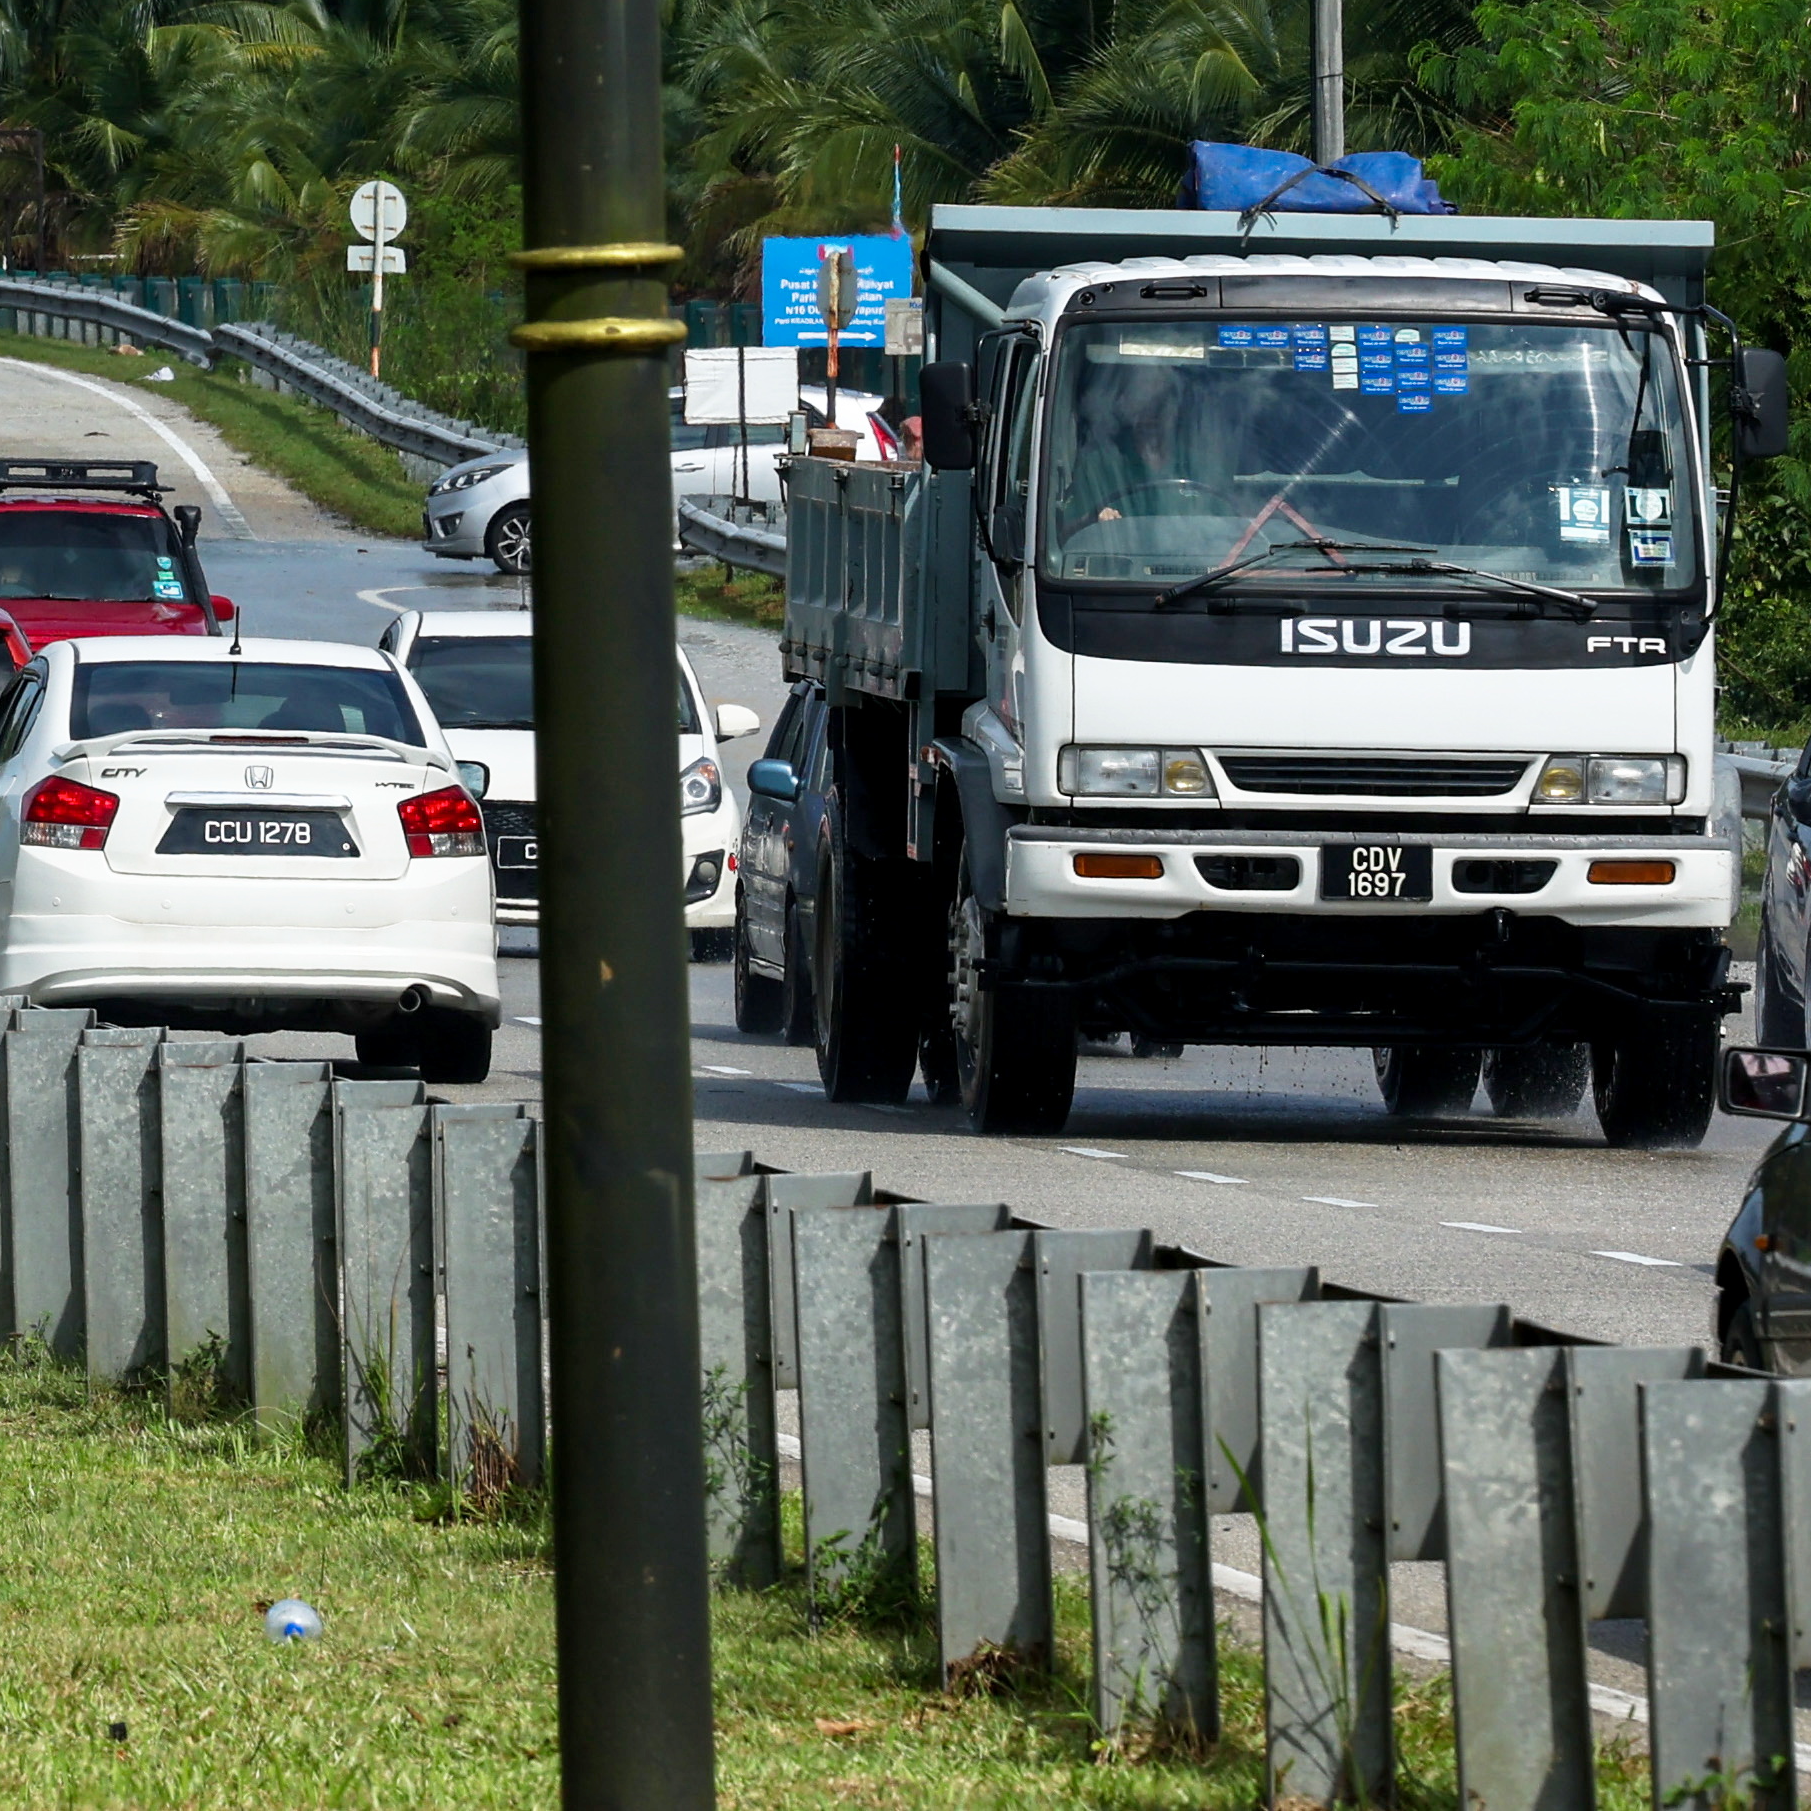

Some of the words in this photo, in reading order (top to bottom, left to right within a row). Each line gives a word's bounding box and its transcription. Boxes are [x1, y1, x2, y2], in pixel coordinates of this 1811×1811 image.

[780, 278, 811, 290] Pusat
[1280, 618, 1471, 656] ISUZU
[1587, 636, 1667, 655] FTR
[101, 767, 147, 779] CITY
[204, 820, 252, 843] CCU
[258, 821, 311, 844] 1278
[1352, 847, 1403, 871] CDV
[1348, 872, 1407, 896] 1697
